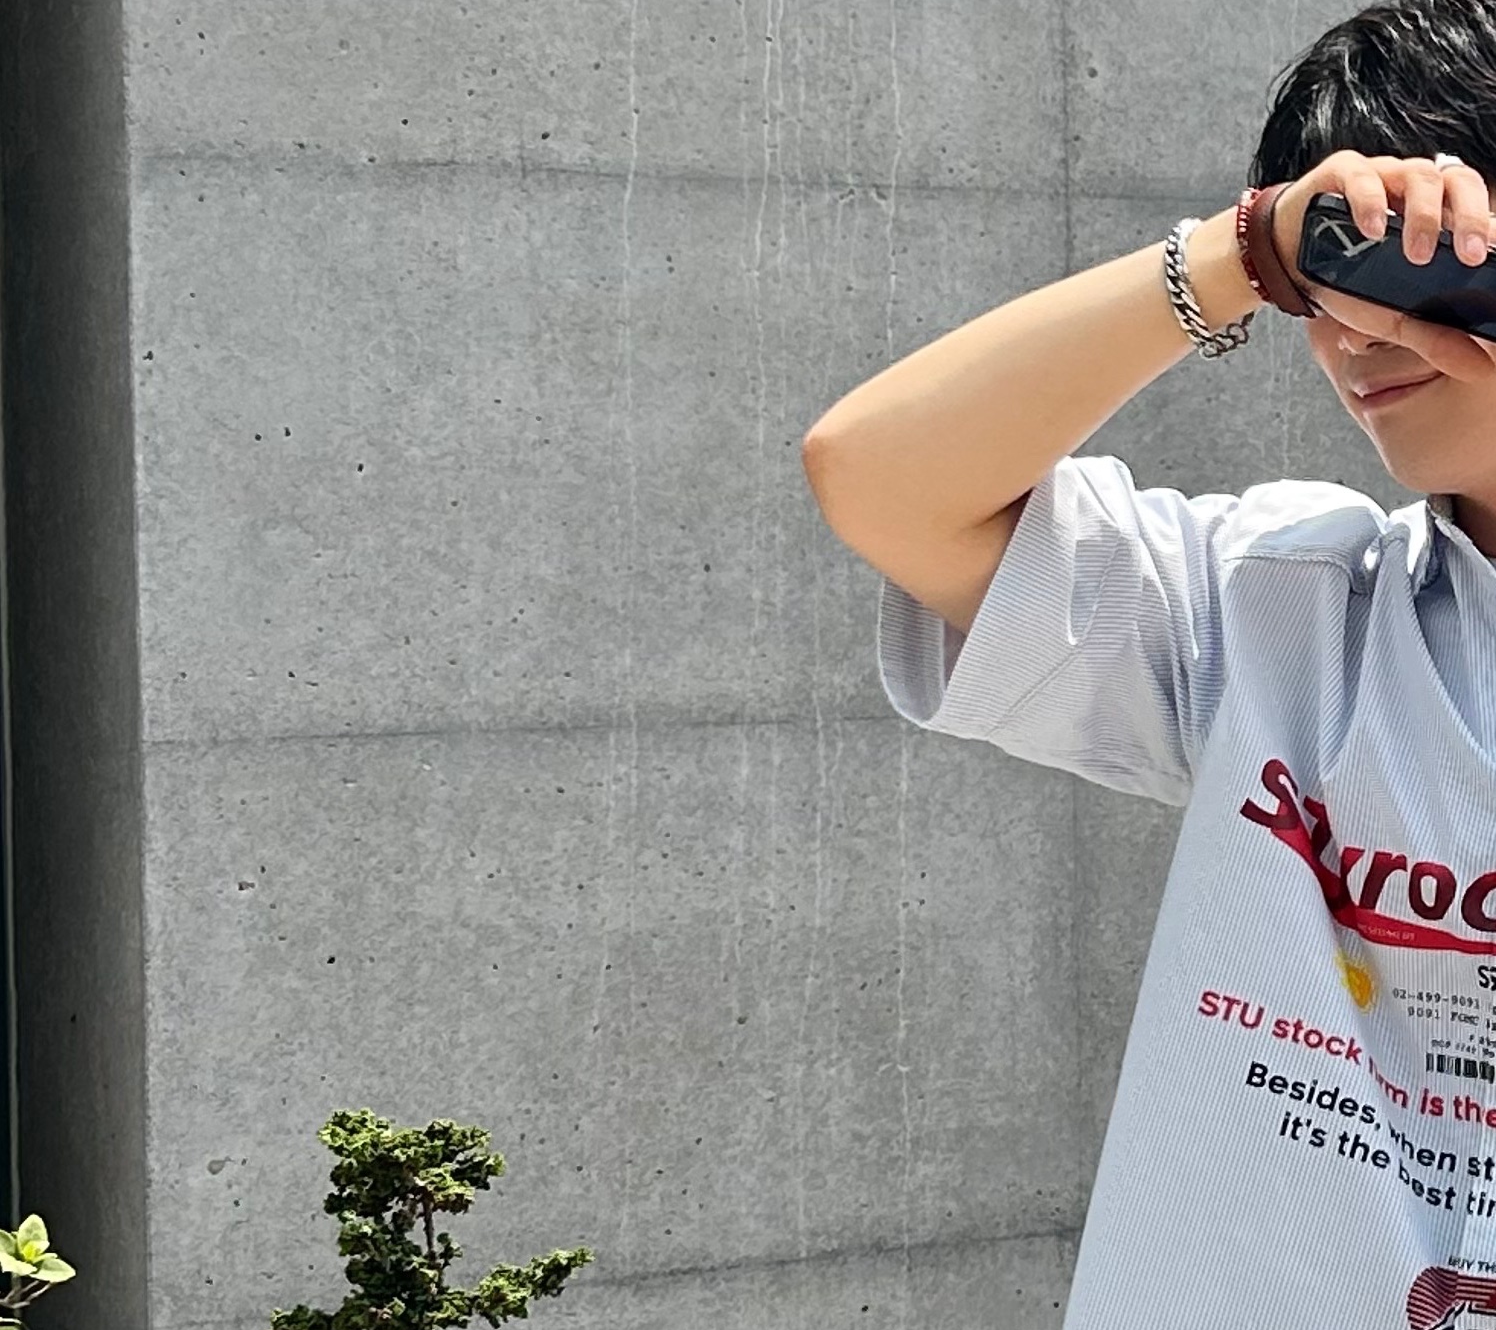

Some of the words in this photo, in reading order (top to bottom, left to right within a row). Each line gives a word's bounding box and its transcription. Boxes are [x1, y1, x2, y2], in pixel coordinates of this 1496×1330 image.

[1198, 991, 1264, 1029] STU
[1272, 1018, 1362, 1065] stock
[1419, 1088, 1444, 1117] is
[1246, 1061, 1380, 1130] Besides,
[1279, 1112, 1327, 1147] it's
[1337, 1131, 1391, 1169] the
[1399, 1158, 1456, 1211] best
